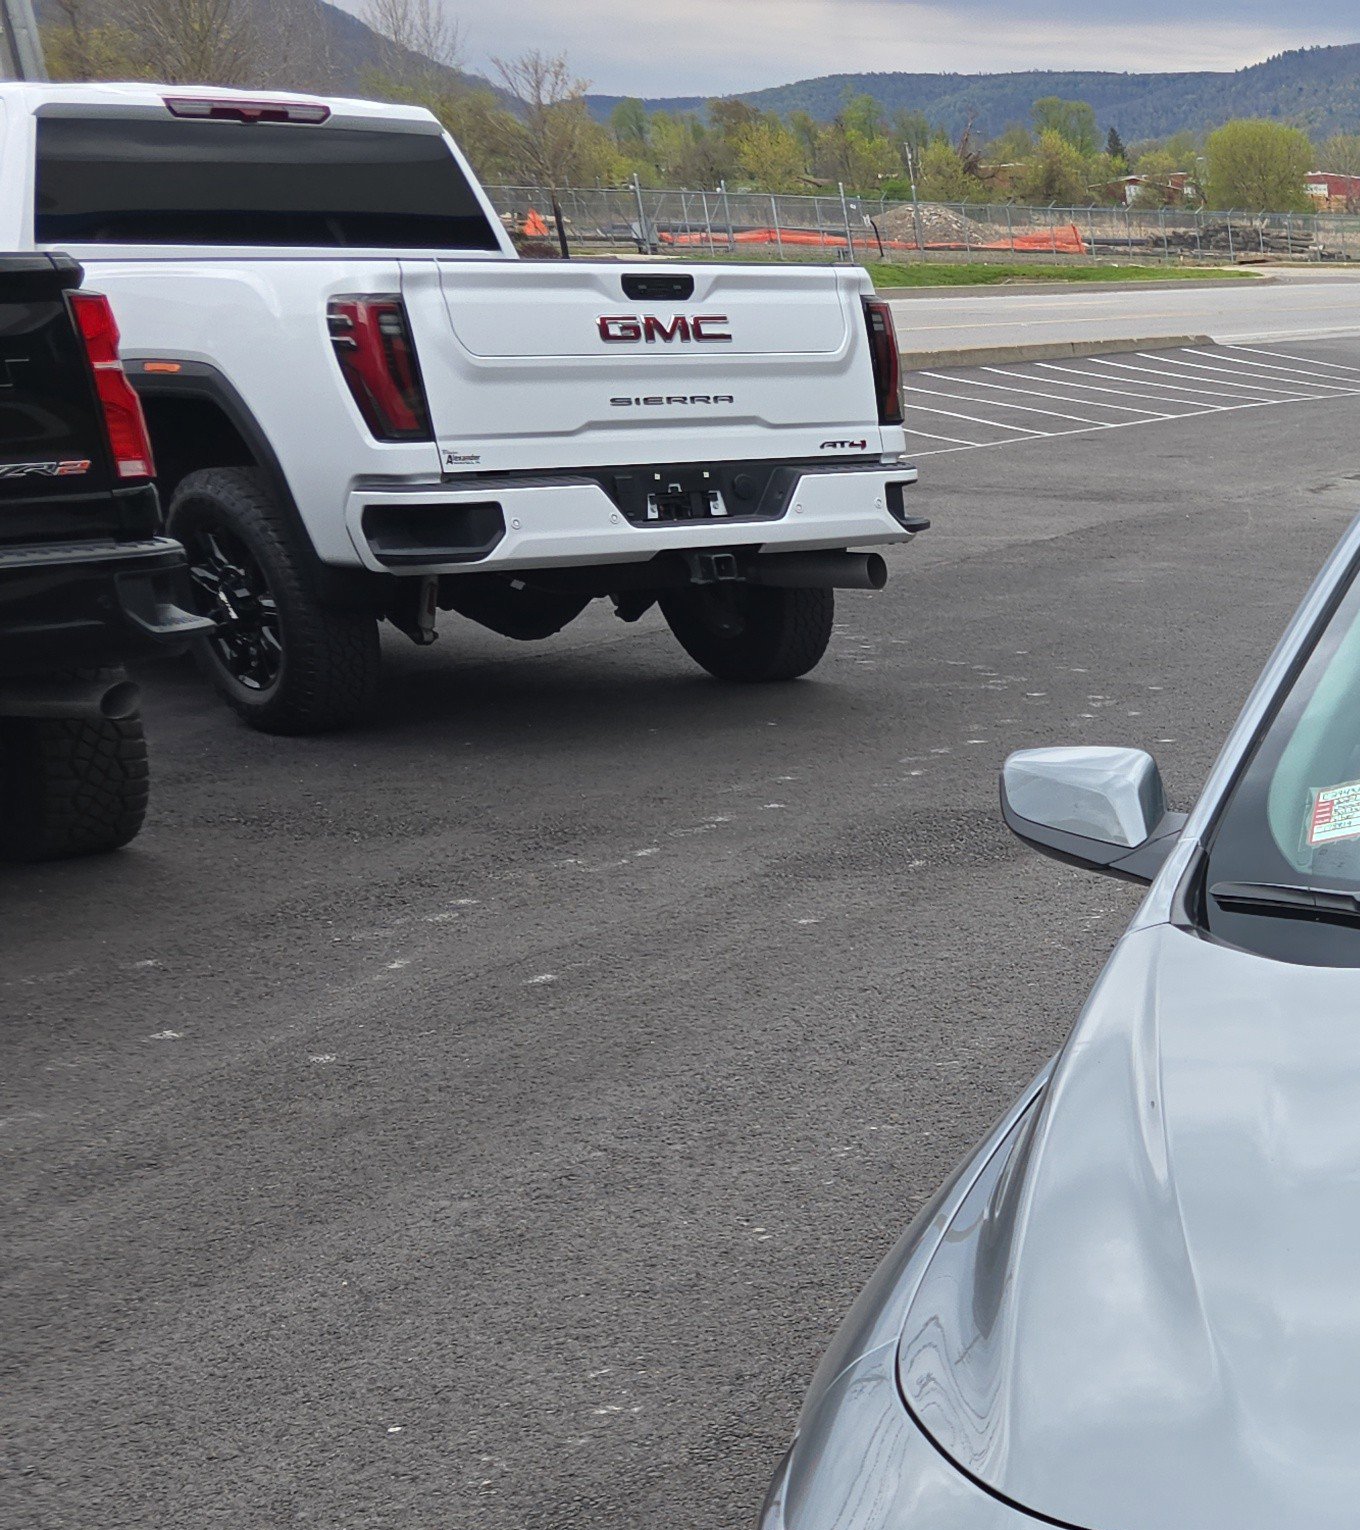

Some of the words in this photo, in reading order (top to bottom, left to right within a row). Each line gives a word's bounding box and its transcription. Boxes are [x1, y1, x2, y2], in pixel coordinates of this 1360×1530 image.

[595, 313, 732, 344] GMC
[610, 395, 734, 407] SIERRA
[819, 439, 867, 450] AT4
